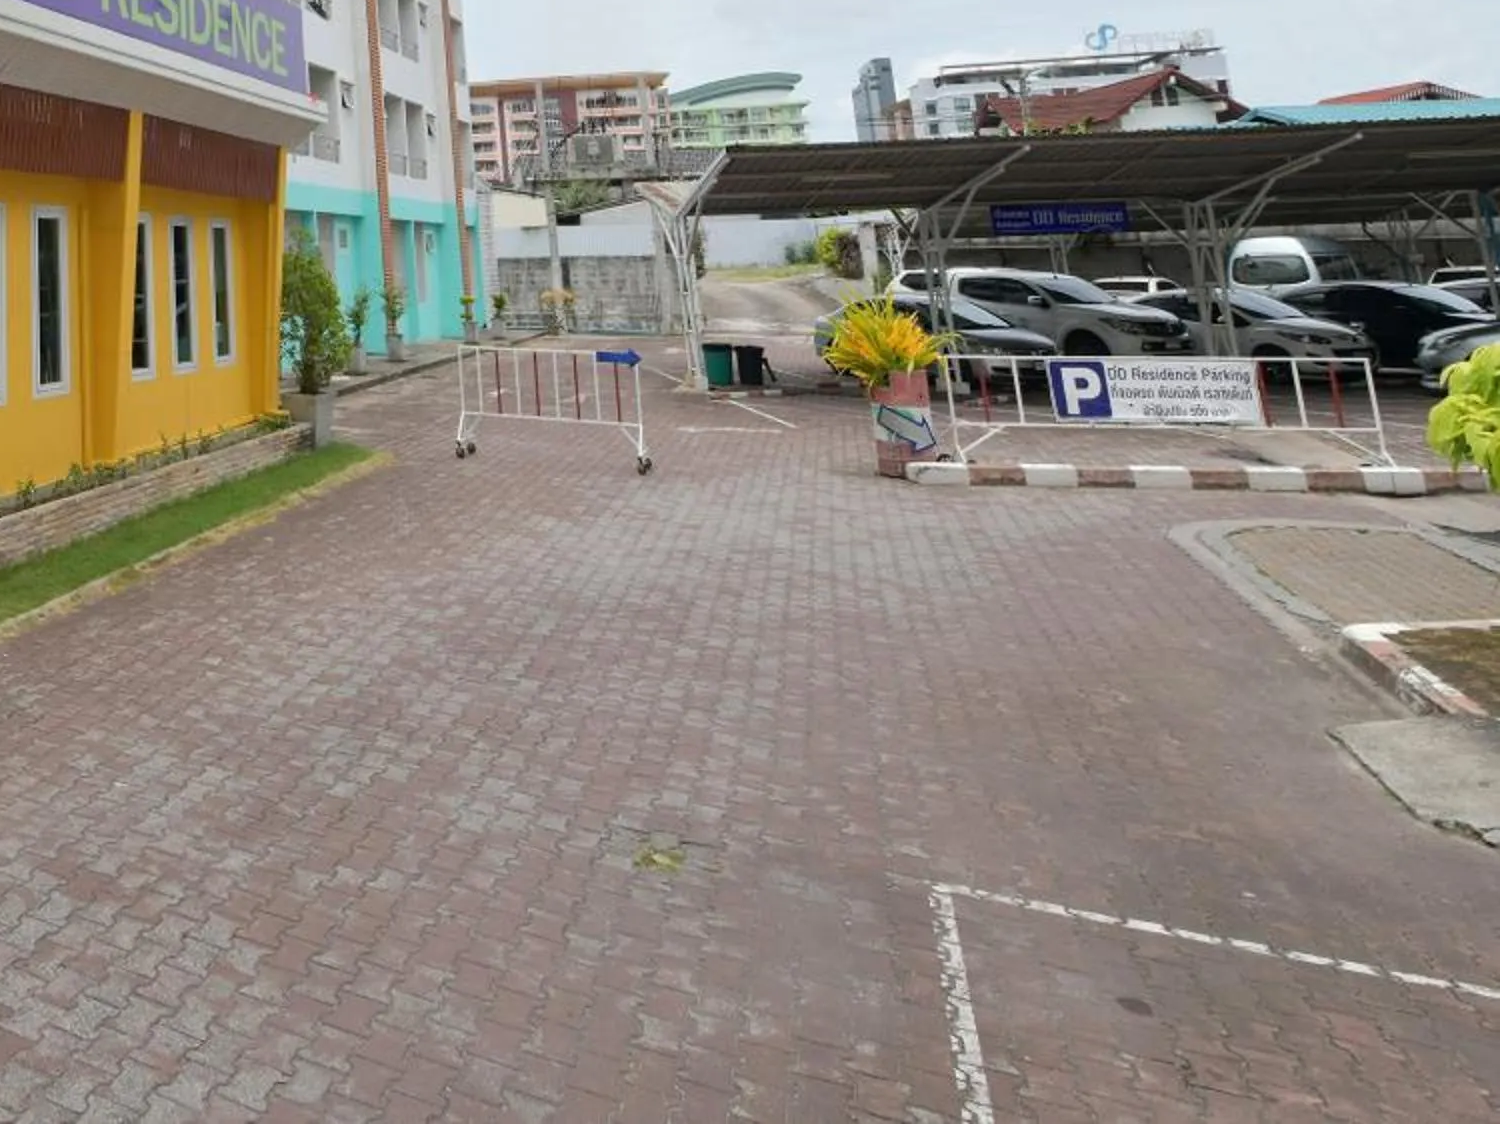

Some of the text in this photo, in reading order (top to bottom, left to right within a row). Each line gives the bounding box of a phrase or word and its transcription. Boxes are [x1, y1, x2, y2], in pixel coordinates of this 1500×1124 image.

[1059, 367, 1102, 415] P
[1107, 366, 1251, 385] DD Residence Parking
